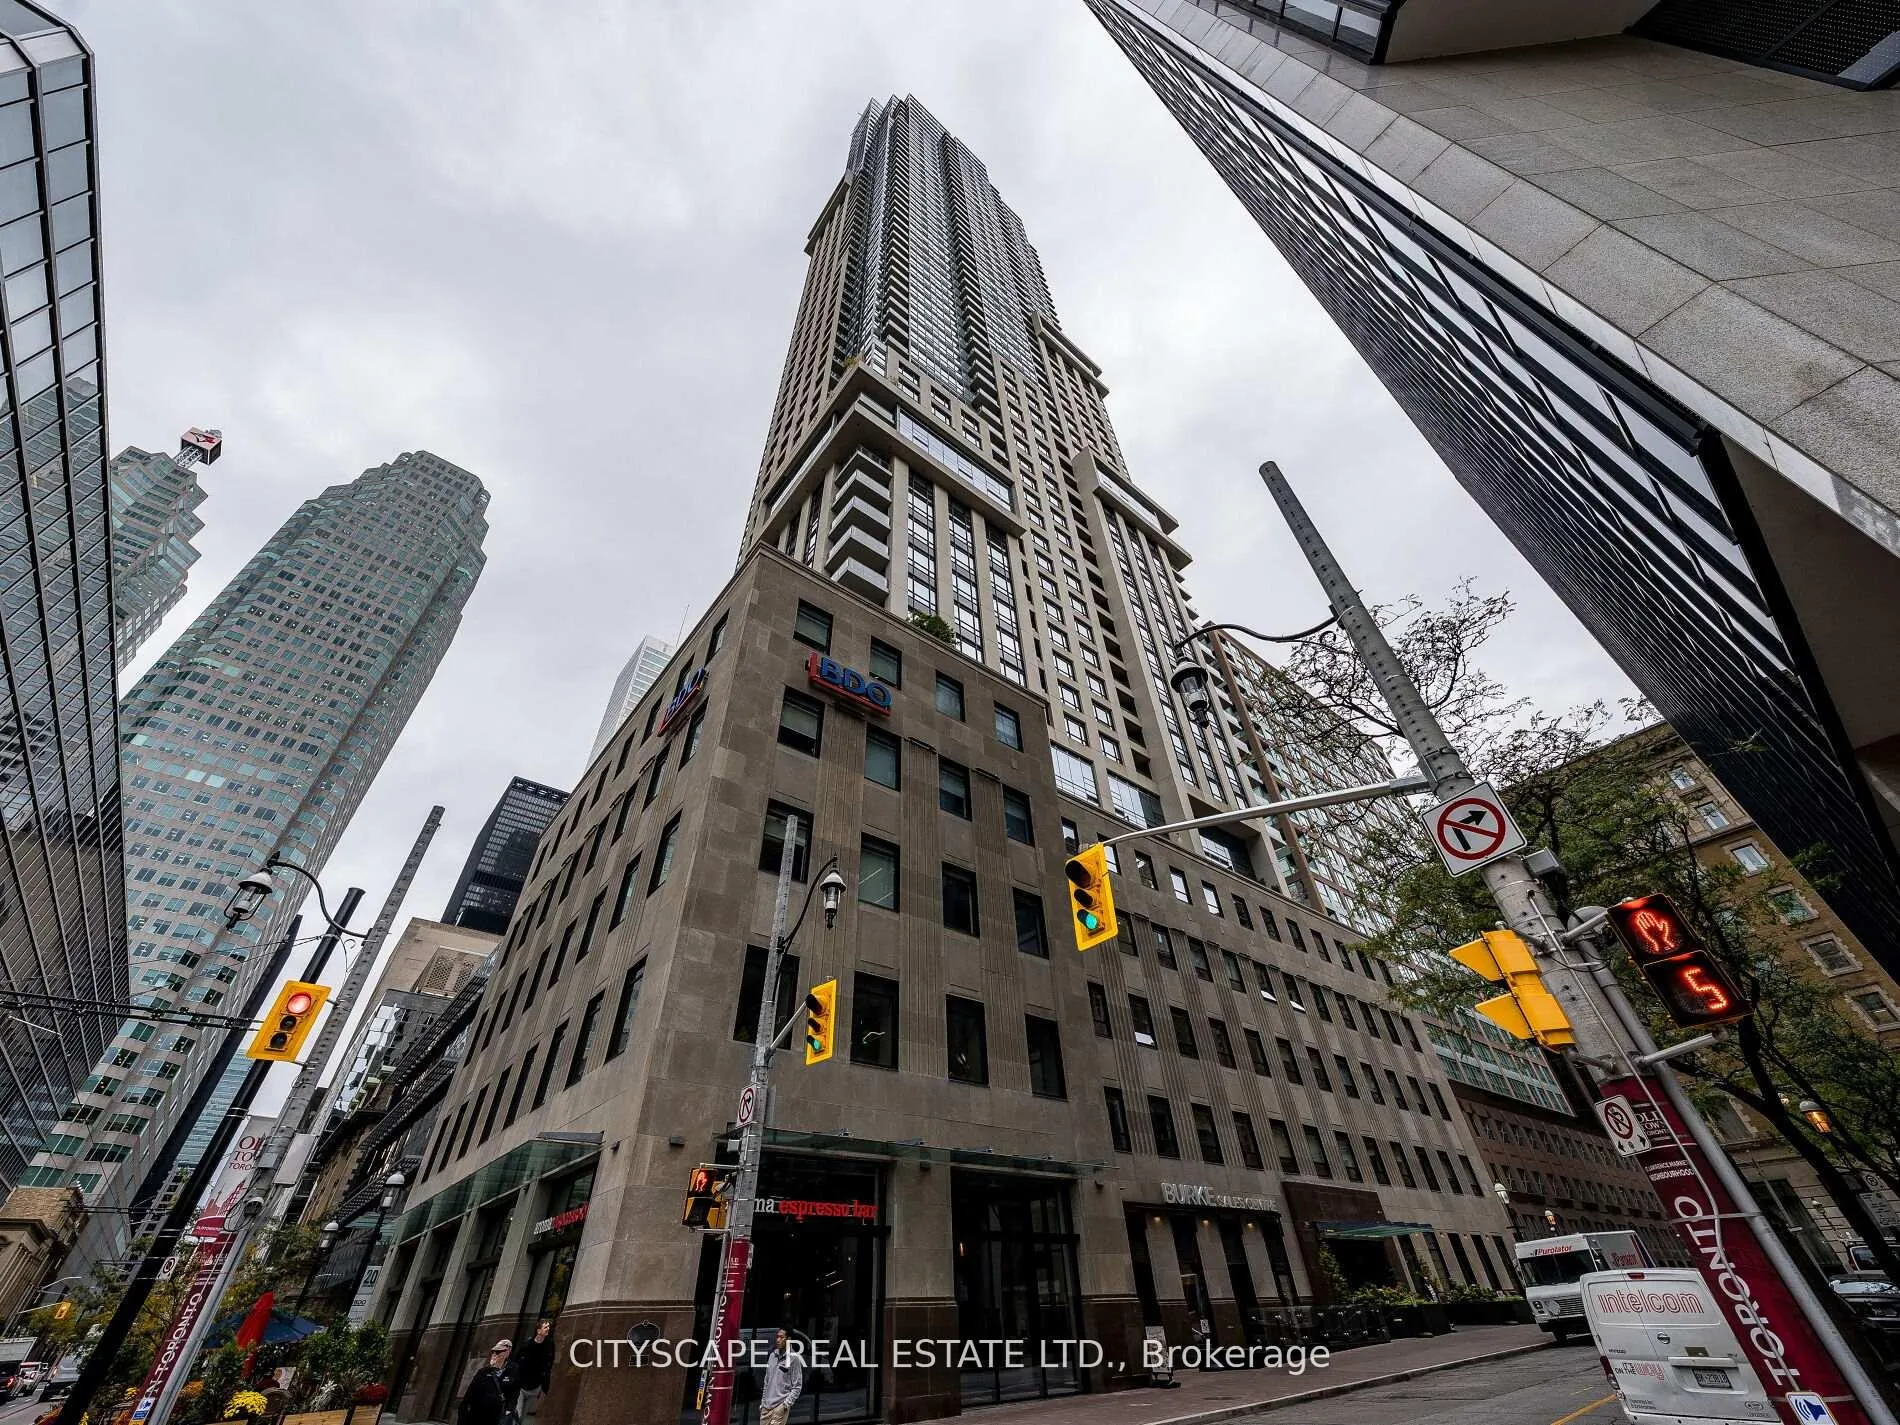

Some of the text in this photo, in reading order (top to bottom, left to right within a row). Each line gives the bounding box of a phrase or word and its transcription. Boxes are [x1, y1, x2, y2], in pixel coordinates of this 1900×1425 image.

[821, 656, 893, 708] BDO
[1684, 966, 1728, 1010] 5
[229, 1162, 252, 1171] TORO
[233, 1151, 255, 1162] TO
[1161, 1182, 1217, 1206] BURKE
[779, 1199, 849, 1222] espresso
[1536, 1244, 1573, 1257] Purolator
[363, 1269, 379, 1284] 20
[1674, 1196, 1801, 1386] TORONTO
[154, 1293, 203, 1377] TORONTO
